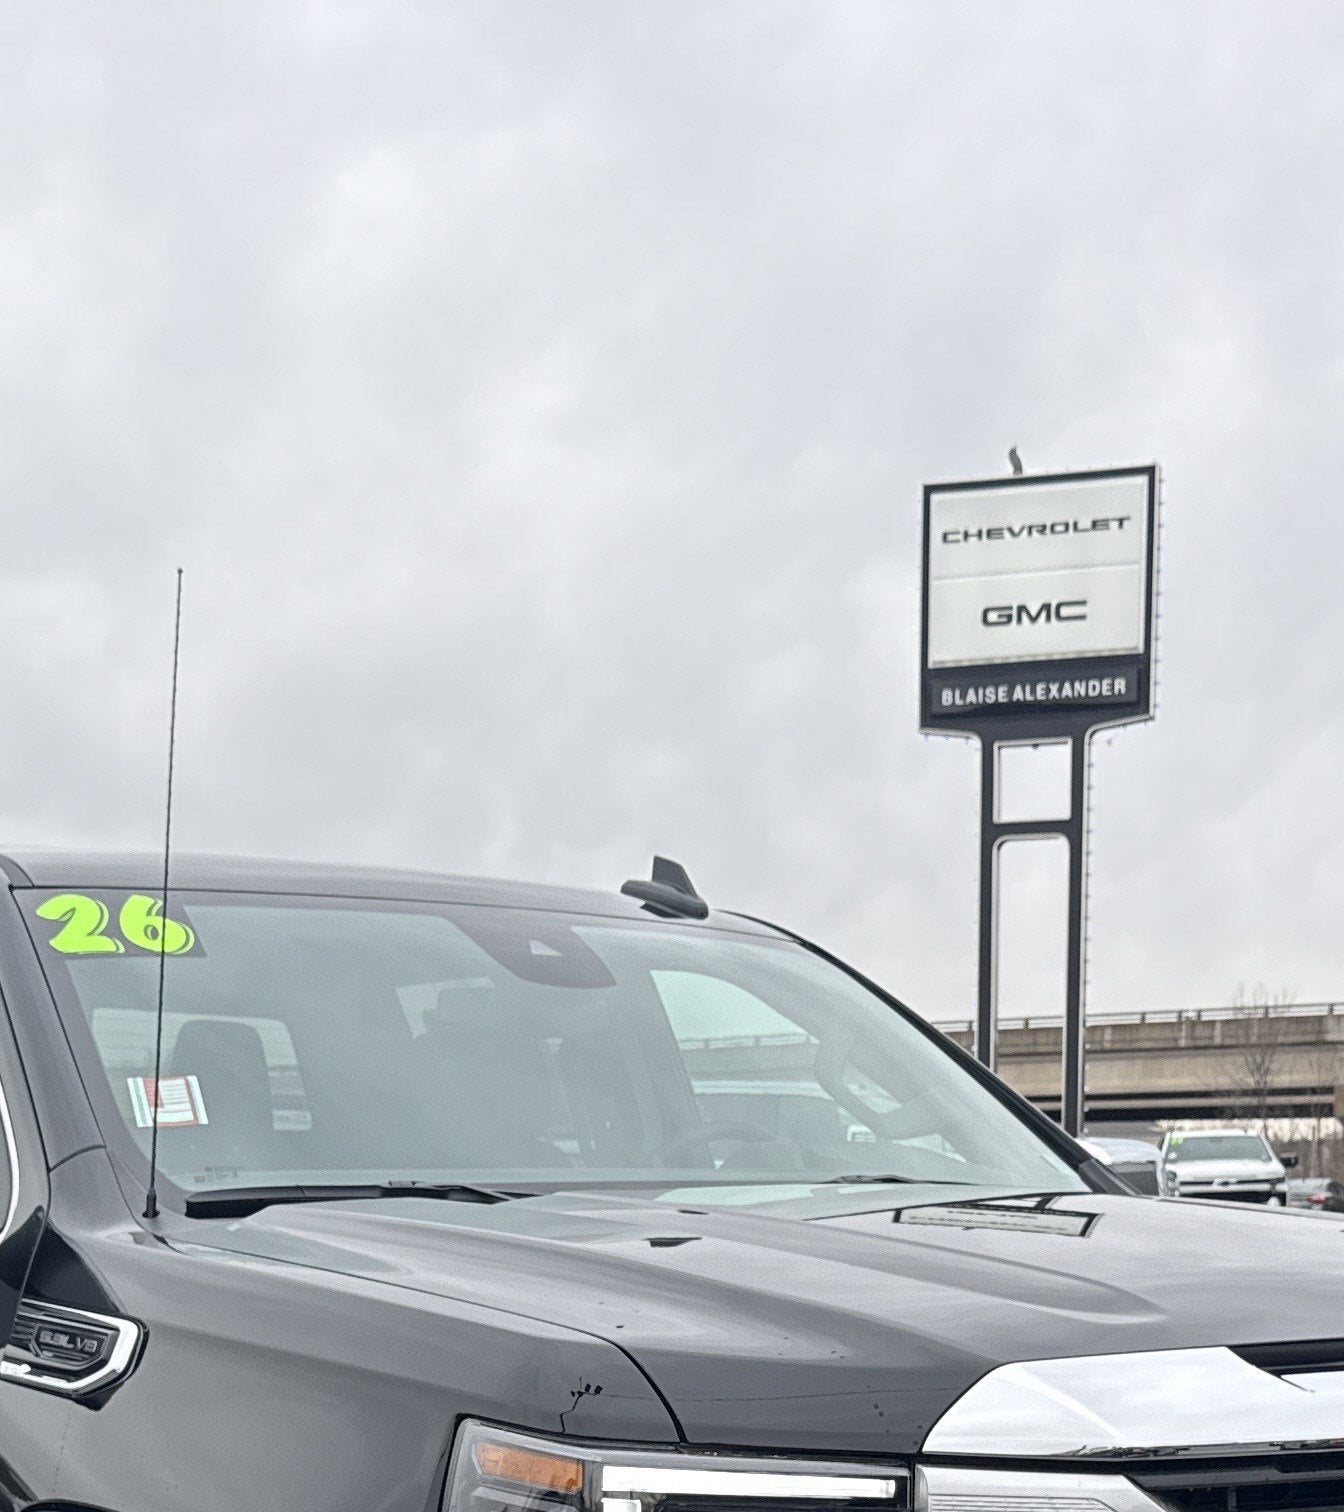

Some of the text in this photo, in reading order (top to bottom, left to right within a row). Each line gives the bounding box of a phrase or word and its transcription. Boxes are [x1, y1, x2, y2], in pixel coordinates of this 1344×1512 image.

[942, 516, 1131, 544] CHEVROLET
[981, 600, 1088, 627] GMC
[941, 677, 1127, 706] BLAISE ALEXANDER
[35, 893, 196, 955] 26
